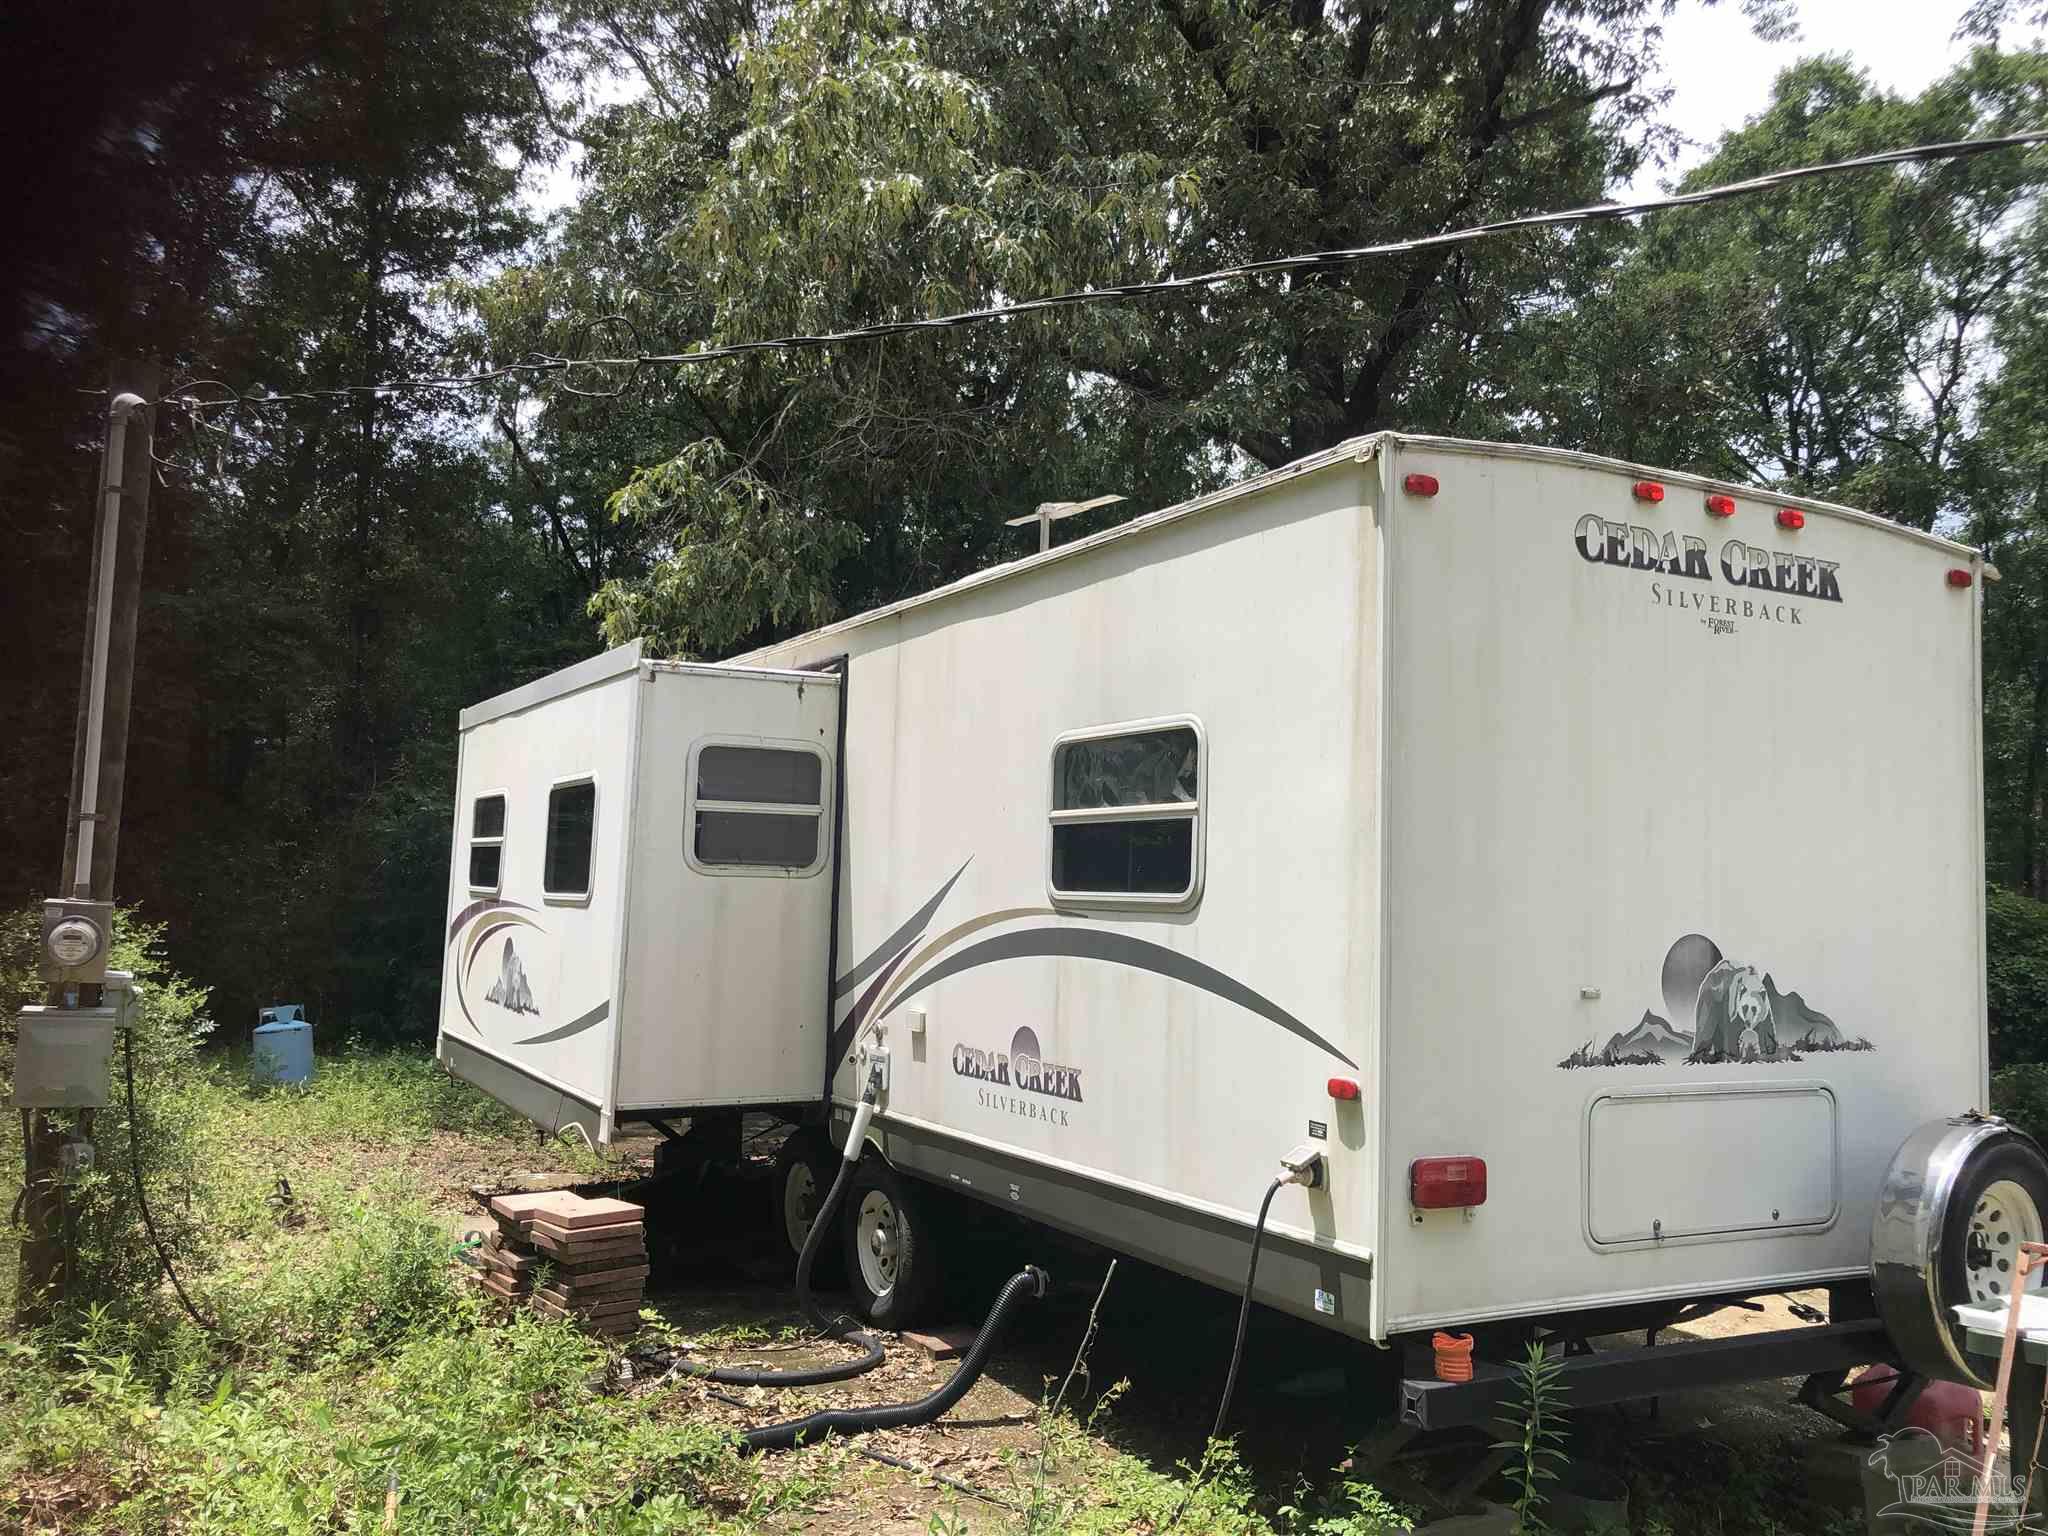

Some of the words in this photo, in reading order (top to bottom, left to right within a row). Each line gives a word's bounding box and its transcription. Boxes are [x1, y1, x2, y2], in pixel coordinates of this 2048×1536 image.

[1574, 513, 1712, 581] CEDAR
[1720, 539, 1844, 603] CREEK
[1651, 582, 1802, 625] SILVERBACK
[952, 1043, 1011, 1086] CEDAR
[1014, 1054, 1083, 1103] CREEK
[977, 1087, 1069, 1127] SILVERBACK
